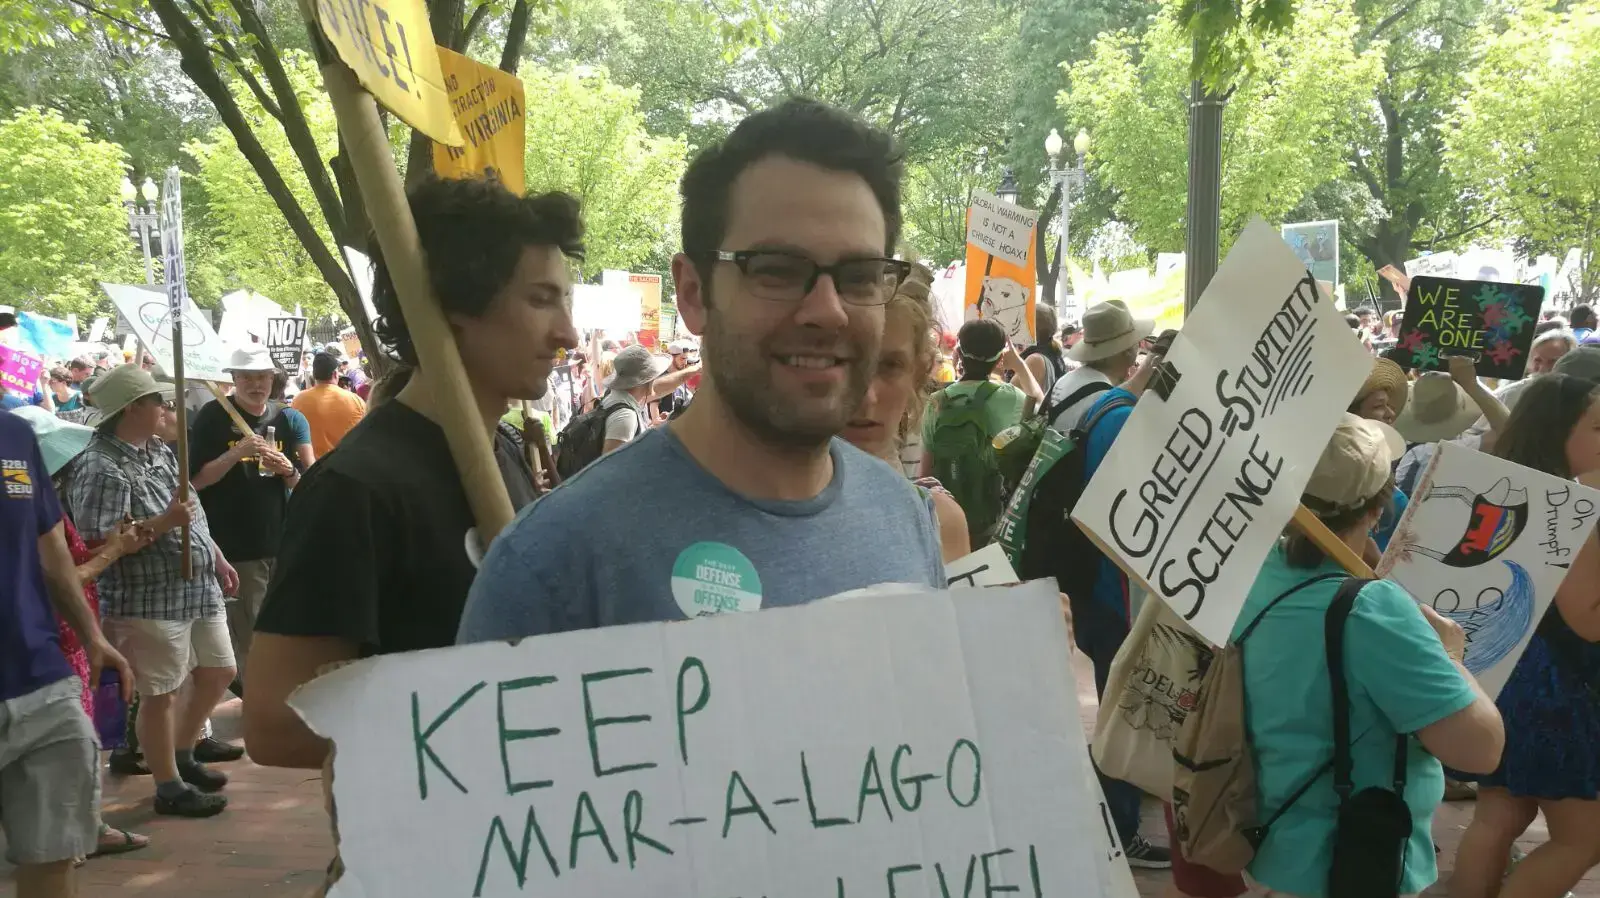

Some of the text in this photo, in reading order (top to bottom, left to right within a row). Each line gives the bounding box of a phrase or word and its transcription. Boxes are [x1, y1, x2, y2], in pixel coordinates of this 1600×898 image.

[464, 95, 522, 148] VIRGINIA
[973, 195, 1034, 228] GLOBAL WARMING
[982, 217, 1015, 240] IS NOT A
[971, 229, 1027, 261] CHINESE HOAX!
[1417, 284, 1461, 308] WE
[268, 319, 305, 346] NO!
[1416, 309, 1473, 331] ARE
[1438, 330, 1487, 350] ONE
[12, 352, 39, 370] NOT
[1159, 434, 1283, 621] SCIENCE
[1539, 485, 1572, 569] Drumpf!
[1571, 498, 1596, 530] Oh
[695, 564, 743, 589] DEFENSE
[411, 657, 710, 802] KEEP
[474, 738, 981, 897] MAR-A-LAGO
